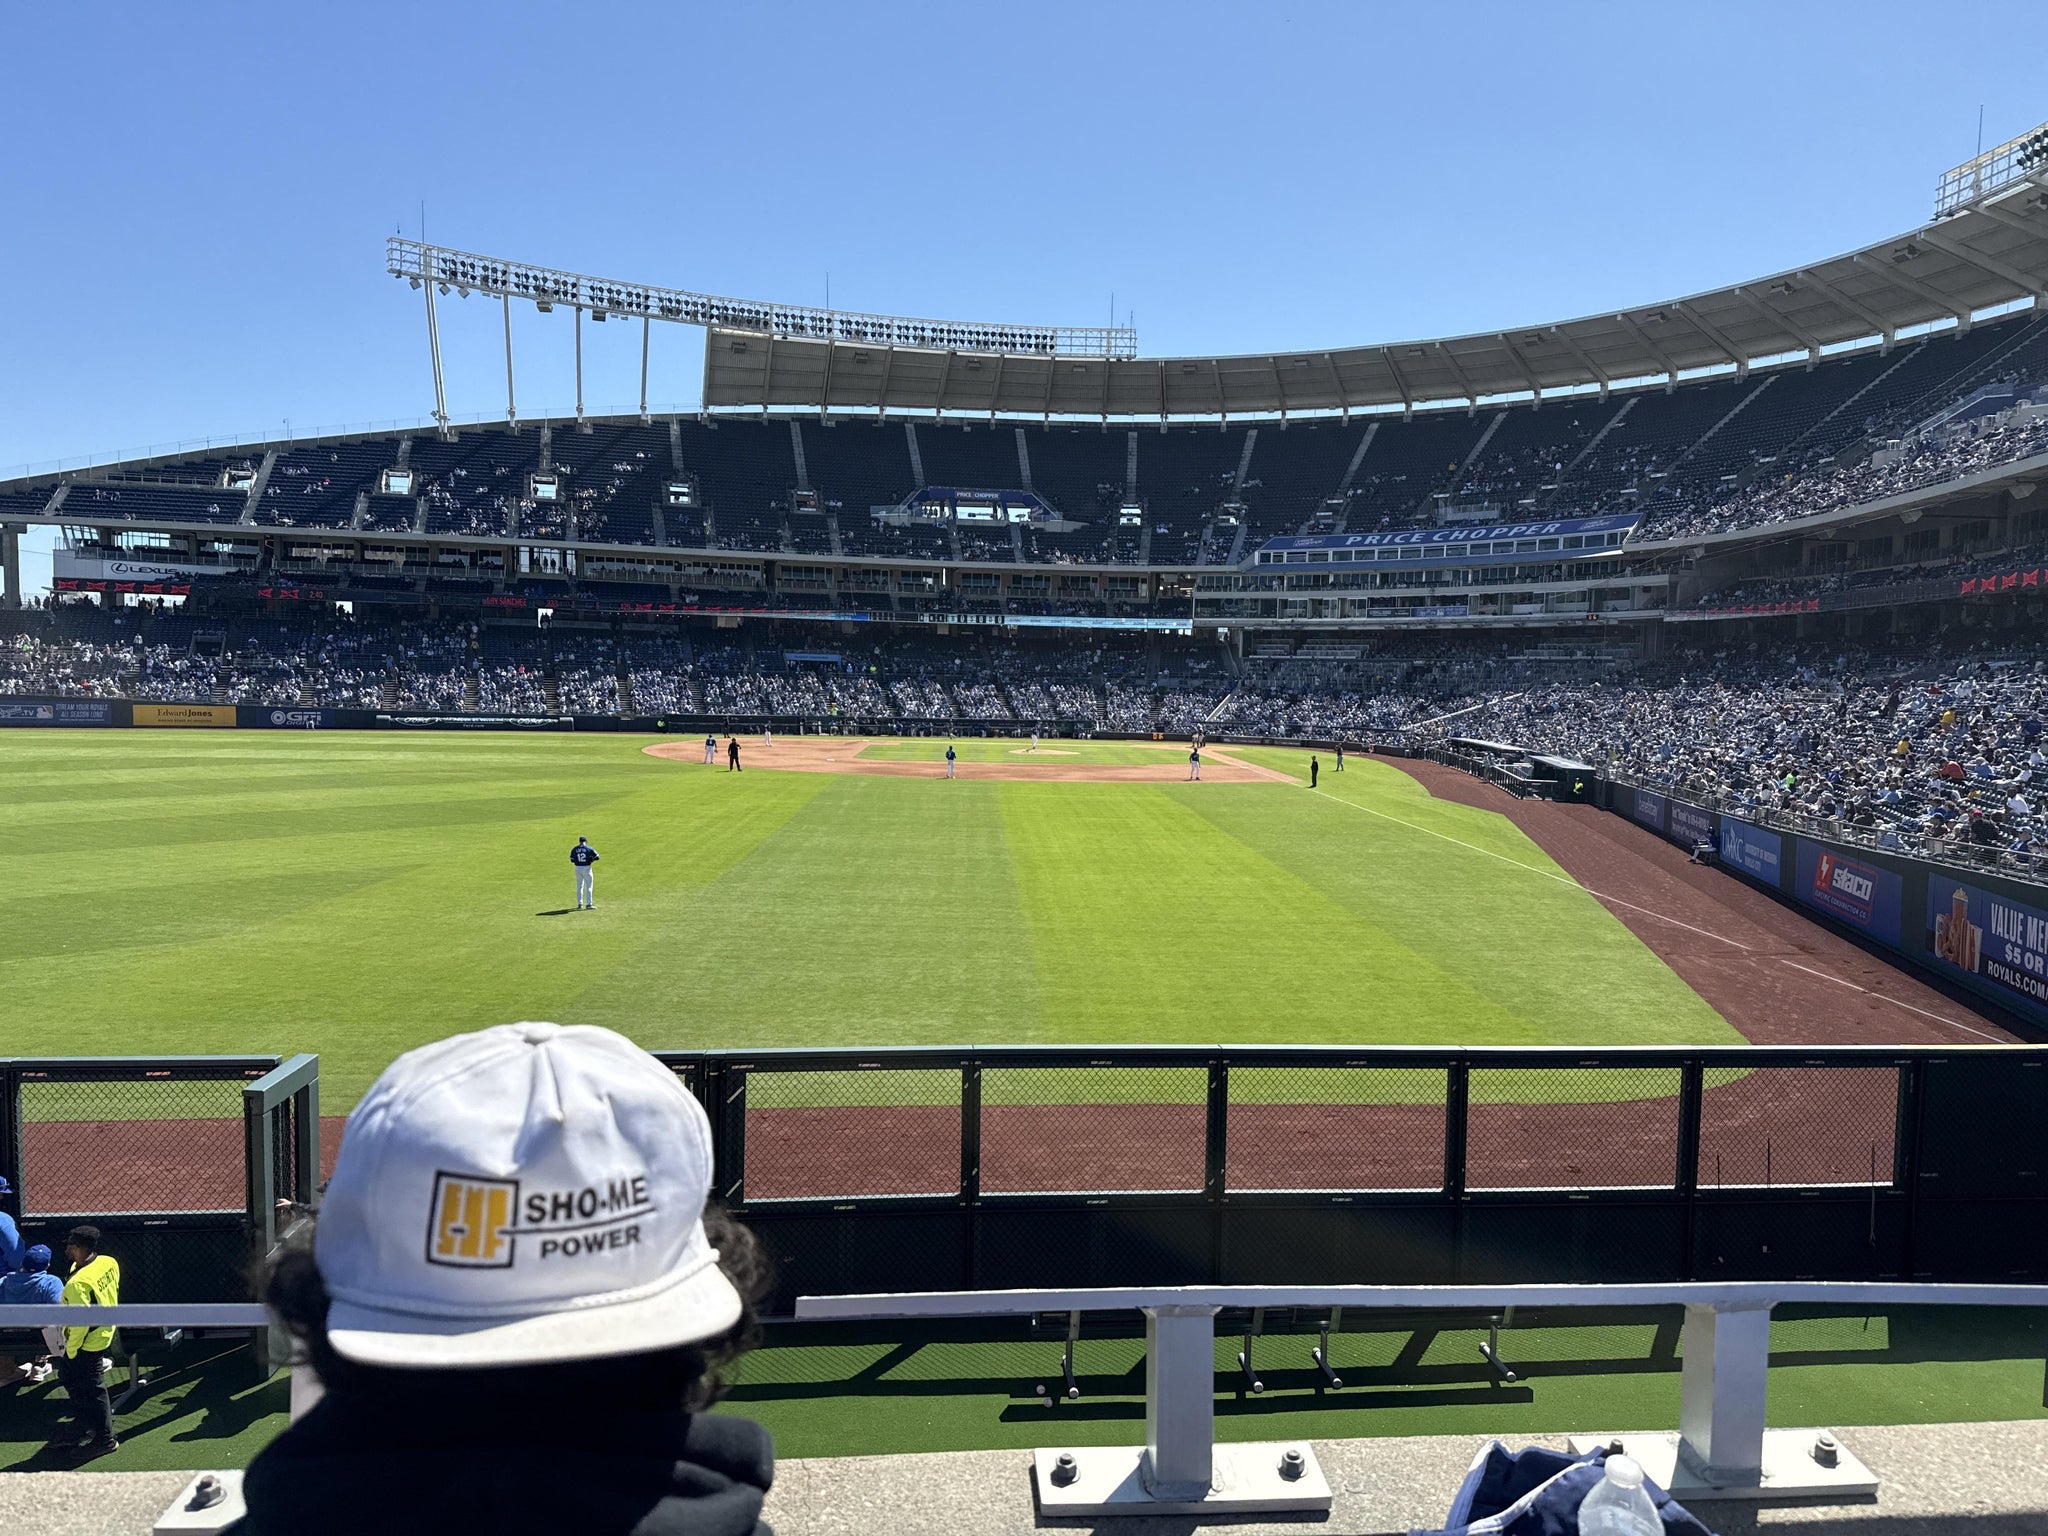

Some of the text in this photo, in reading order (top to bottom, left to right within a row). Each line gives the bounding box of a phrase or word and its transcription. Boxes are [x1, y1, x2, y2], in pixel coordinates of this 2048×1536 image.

[1345, 523, 1561, 545] PRICE CHOPPER
[130, 566, 178, 575] LEXUS
[56, 703, 75, 711] STREAM
[157, 708, 213, 718] Edward Jones
[577, 852, 586, 862] 12
[1832, 867, 1873, 901] staco
[1991, 902, 2024, 946] VALUE
[2005, 942, 2045, 975] $5 OR
[540, 1224, 642, 1260] POWER
